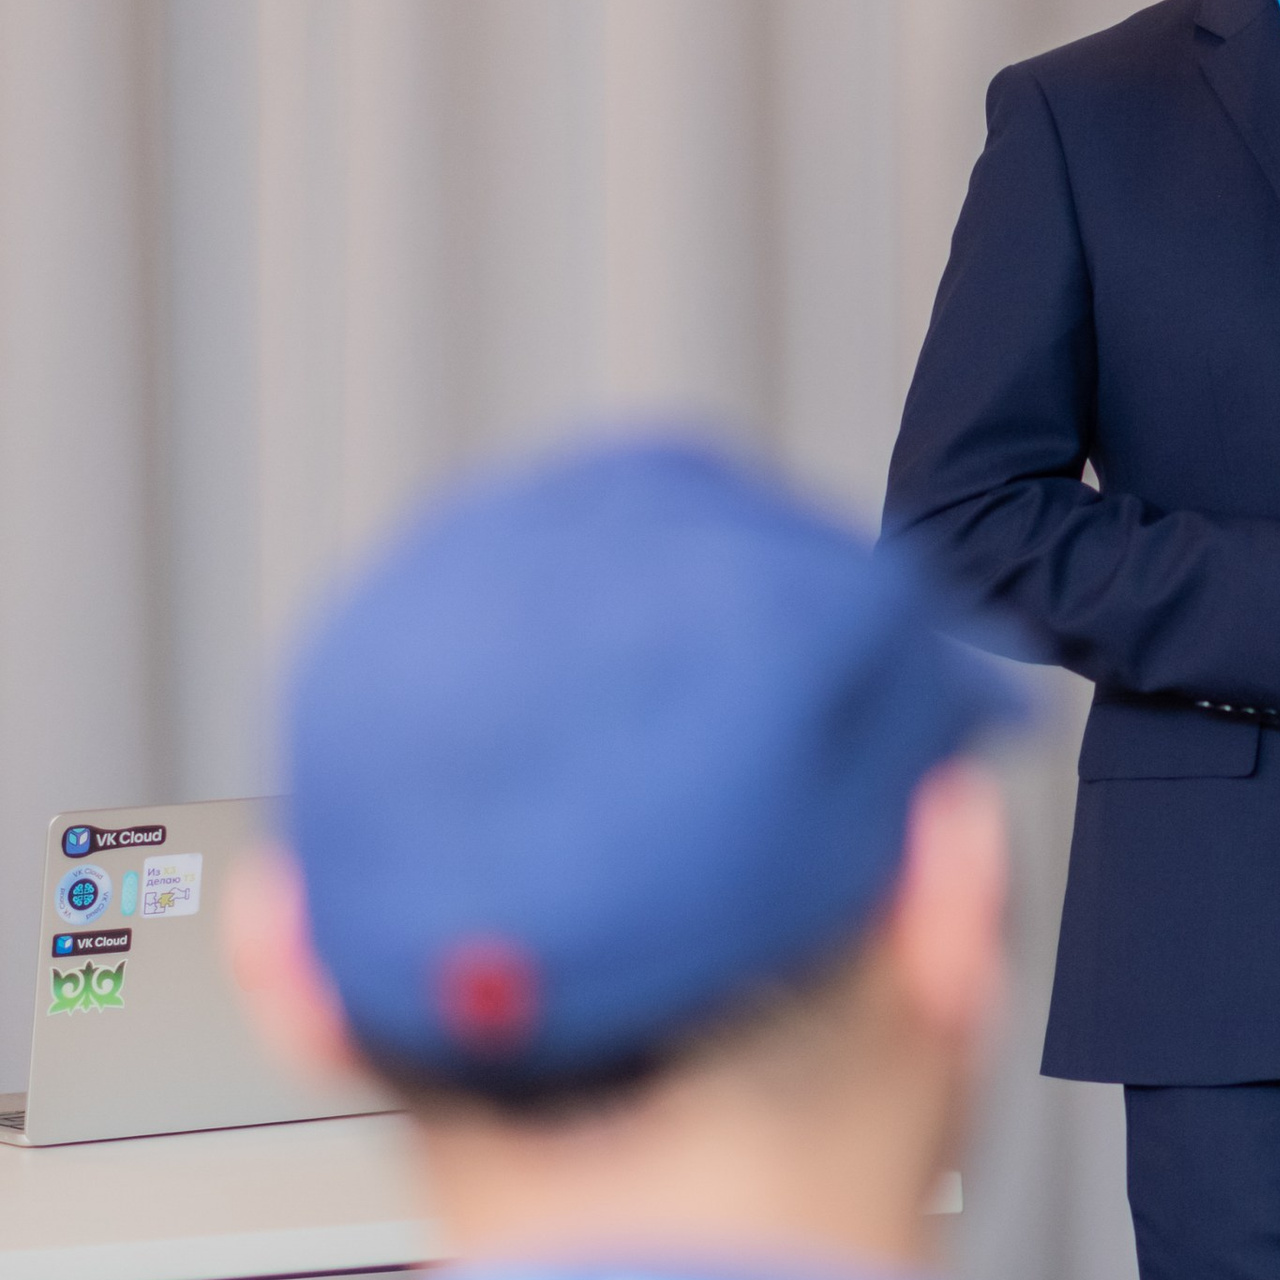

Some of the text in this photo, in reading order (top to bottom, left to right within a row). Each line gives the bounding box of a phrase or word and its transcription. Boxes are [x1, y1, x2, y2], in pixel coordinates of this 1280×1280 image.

[96, 829, 162, 847] VK Cloud
[72, 868, 104, 880] VK Cloud
[147, 868, 161, 877] Из
[146, 877, 181, 887] делаю
[77, 934, 128, 949] VK Cloud
